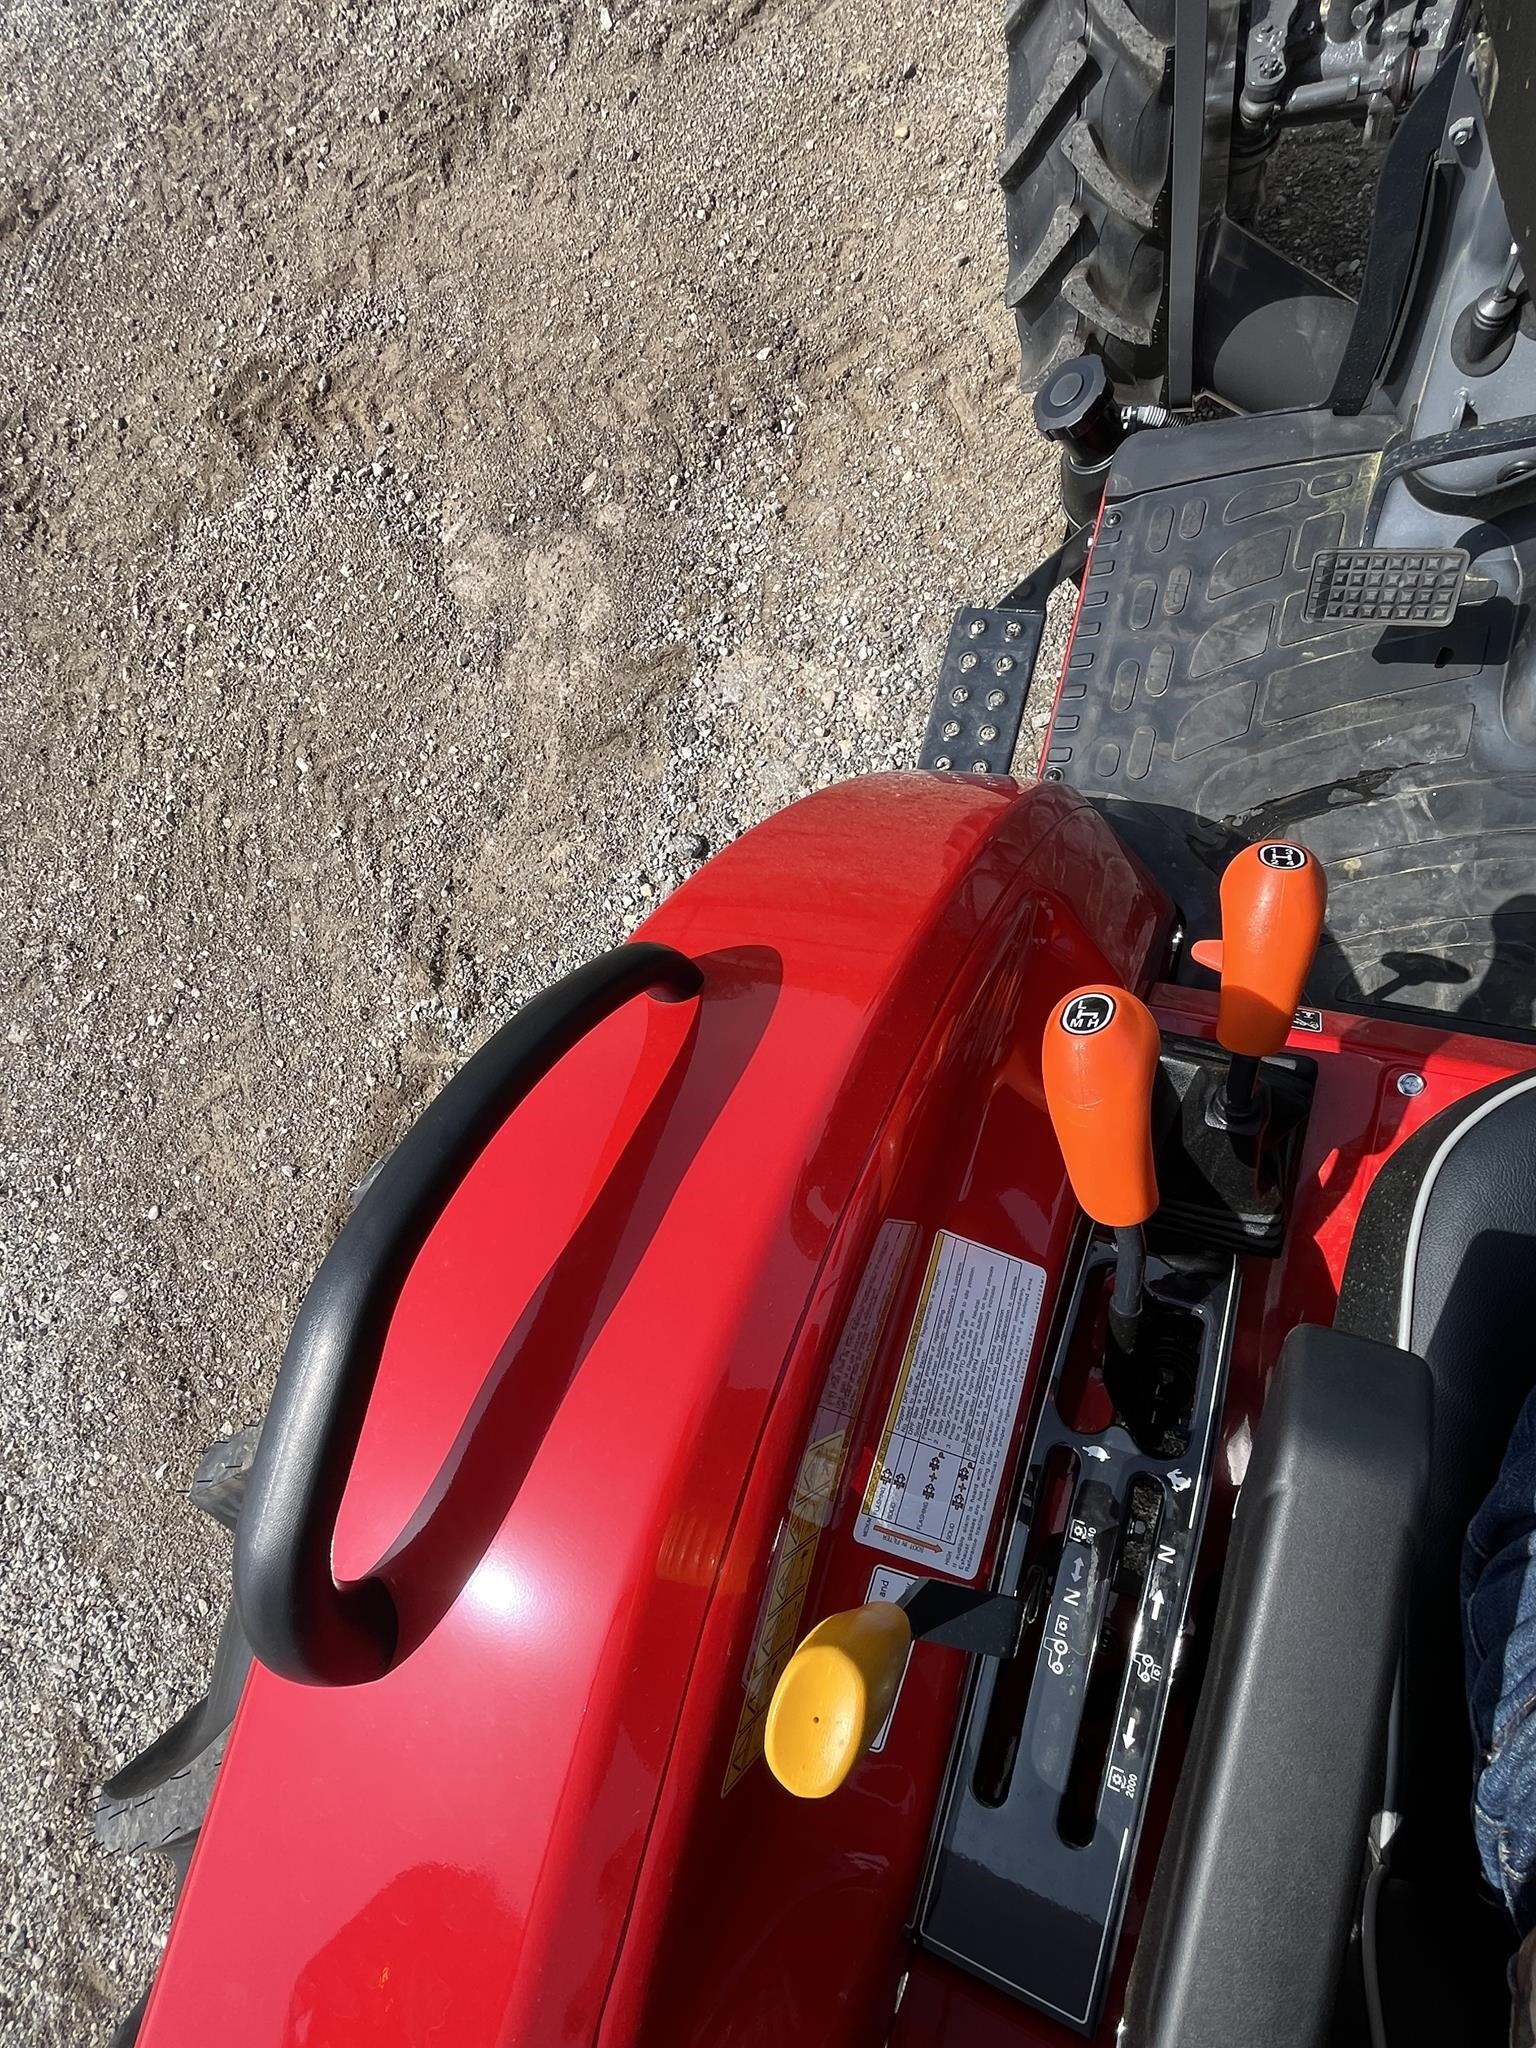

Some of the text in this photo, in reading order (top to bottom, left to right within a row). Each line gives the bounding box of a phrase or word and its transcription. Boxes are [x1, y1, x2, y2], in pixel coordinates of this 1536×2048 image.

[1078, 1000, 1087, 1009] L
[1070, 1018, 1099, 1027] M H
[935, 1418, 944, 1435] Apply
[940, 1394, 950, 1416] parking
[946, 1376, 954, 1393] brake
[955, 1341, 963, 1361] ensure
[959, 1543, 969, 1570] Exhaust
[967, 1518, 977, 1541] gasses
[980, 1467, 990, 1488] during
[1020, 1293, 1029, 1318] confined
[955, 1535, 964, 1560] audible
[962, 1514, 970, 1533] alarm
[970, 1483, 978, 1502] heard
[983, 1420, 994, 1447] indicator
[992, 1388, 1002, 1412] perform
[999, 1364, 1008, 1385] parked
[916, 1500, 928, 1530] FLASHING
[946, 1522, 954, 1540] SOLID
[944, 1550, 952, 1565] HIGH
[1157, 1545, 1176, 1564] N
[880, 1580, 889, 1598] and
[1063, 1587, 1081, 1606] N
[1125, 1774, 1138, 1799] 2000
